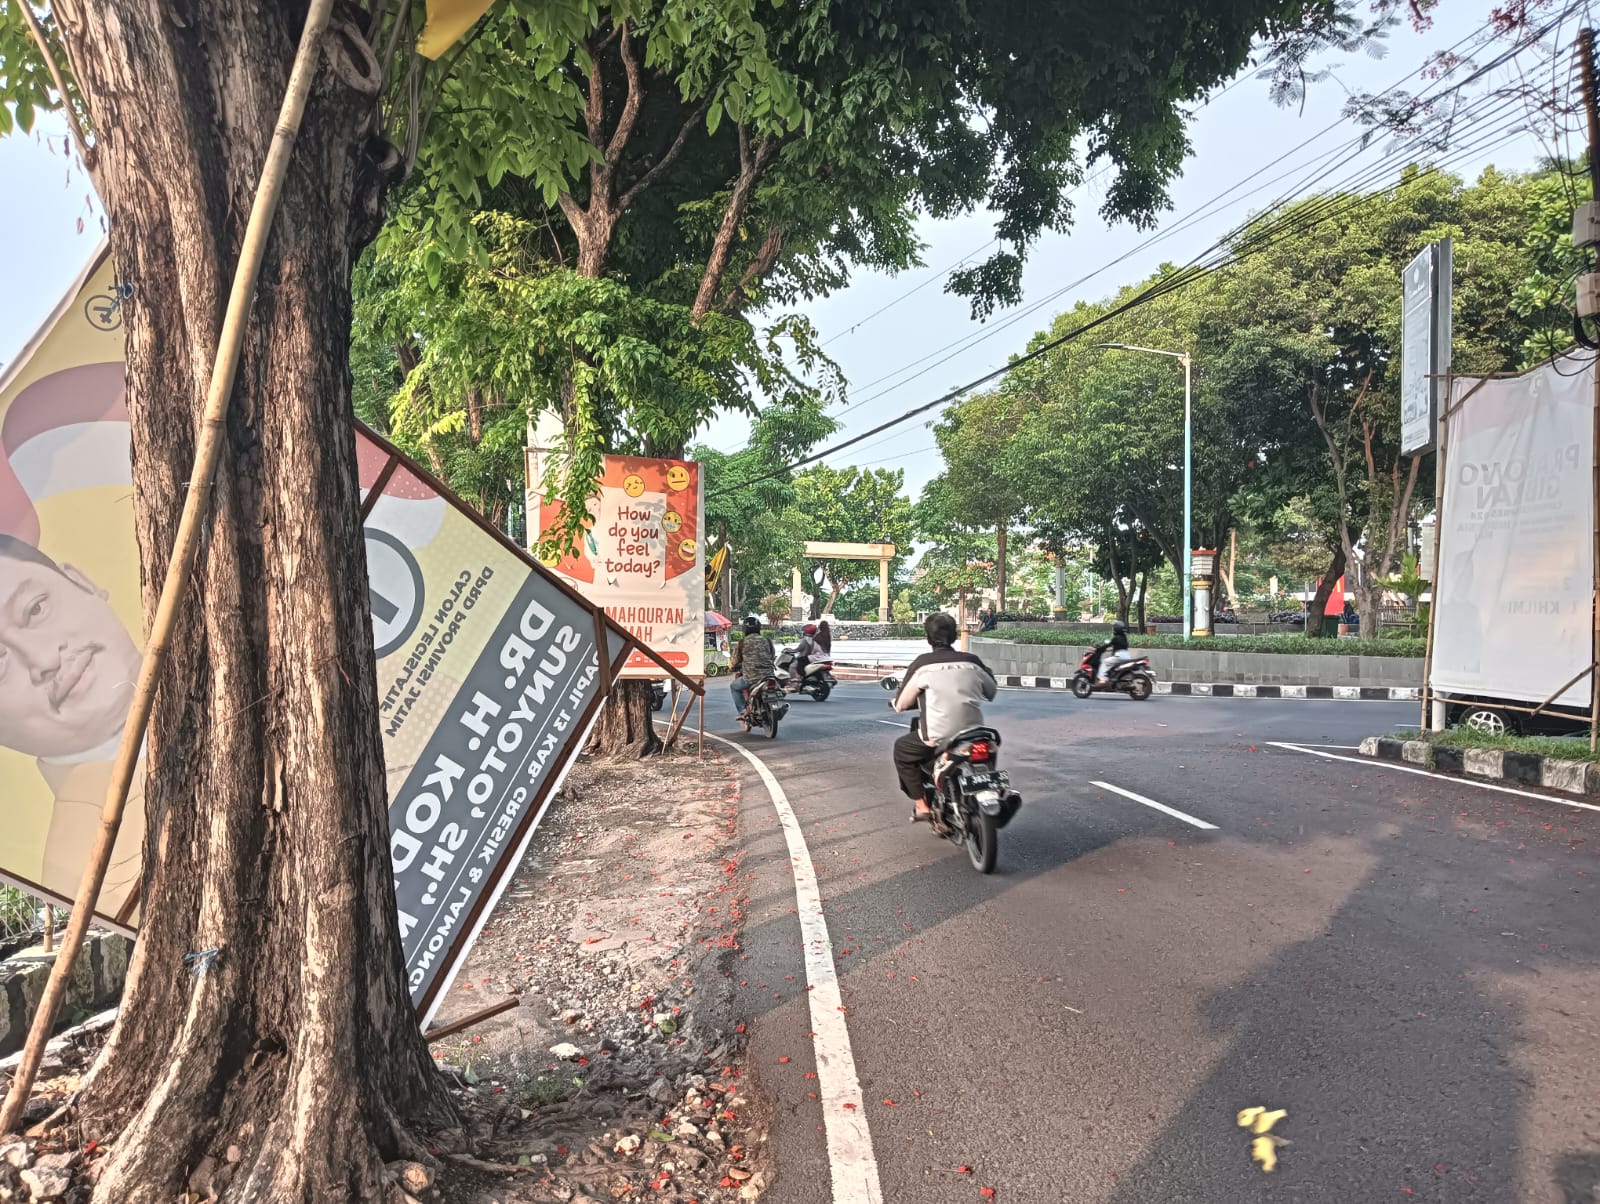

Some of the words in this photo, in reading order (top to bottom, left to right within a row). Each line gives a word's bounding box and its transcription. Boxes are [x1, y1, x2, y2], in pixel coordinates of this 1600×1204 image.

[617, 506, 651, 521] How
[608, 522, 628, 537] do
[631, 526, 659, 542] you
[617, 538, 650, 557] feel
[605, 558, 661, 578] today?
